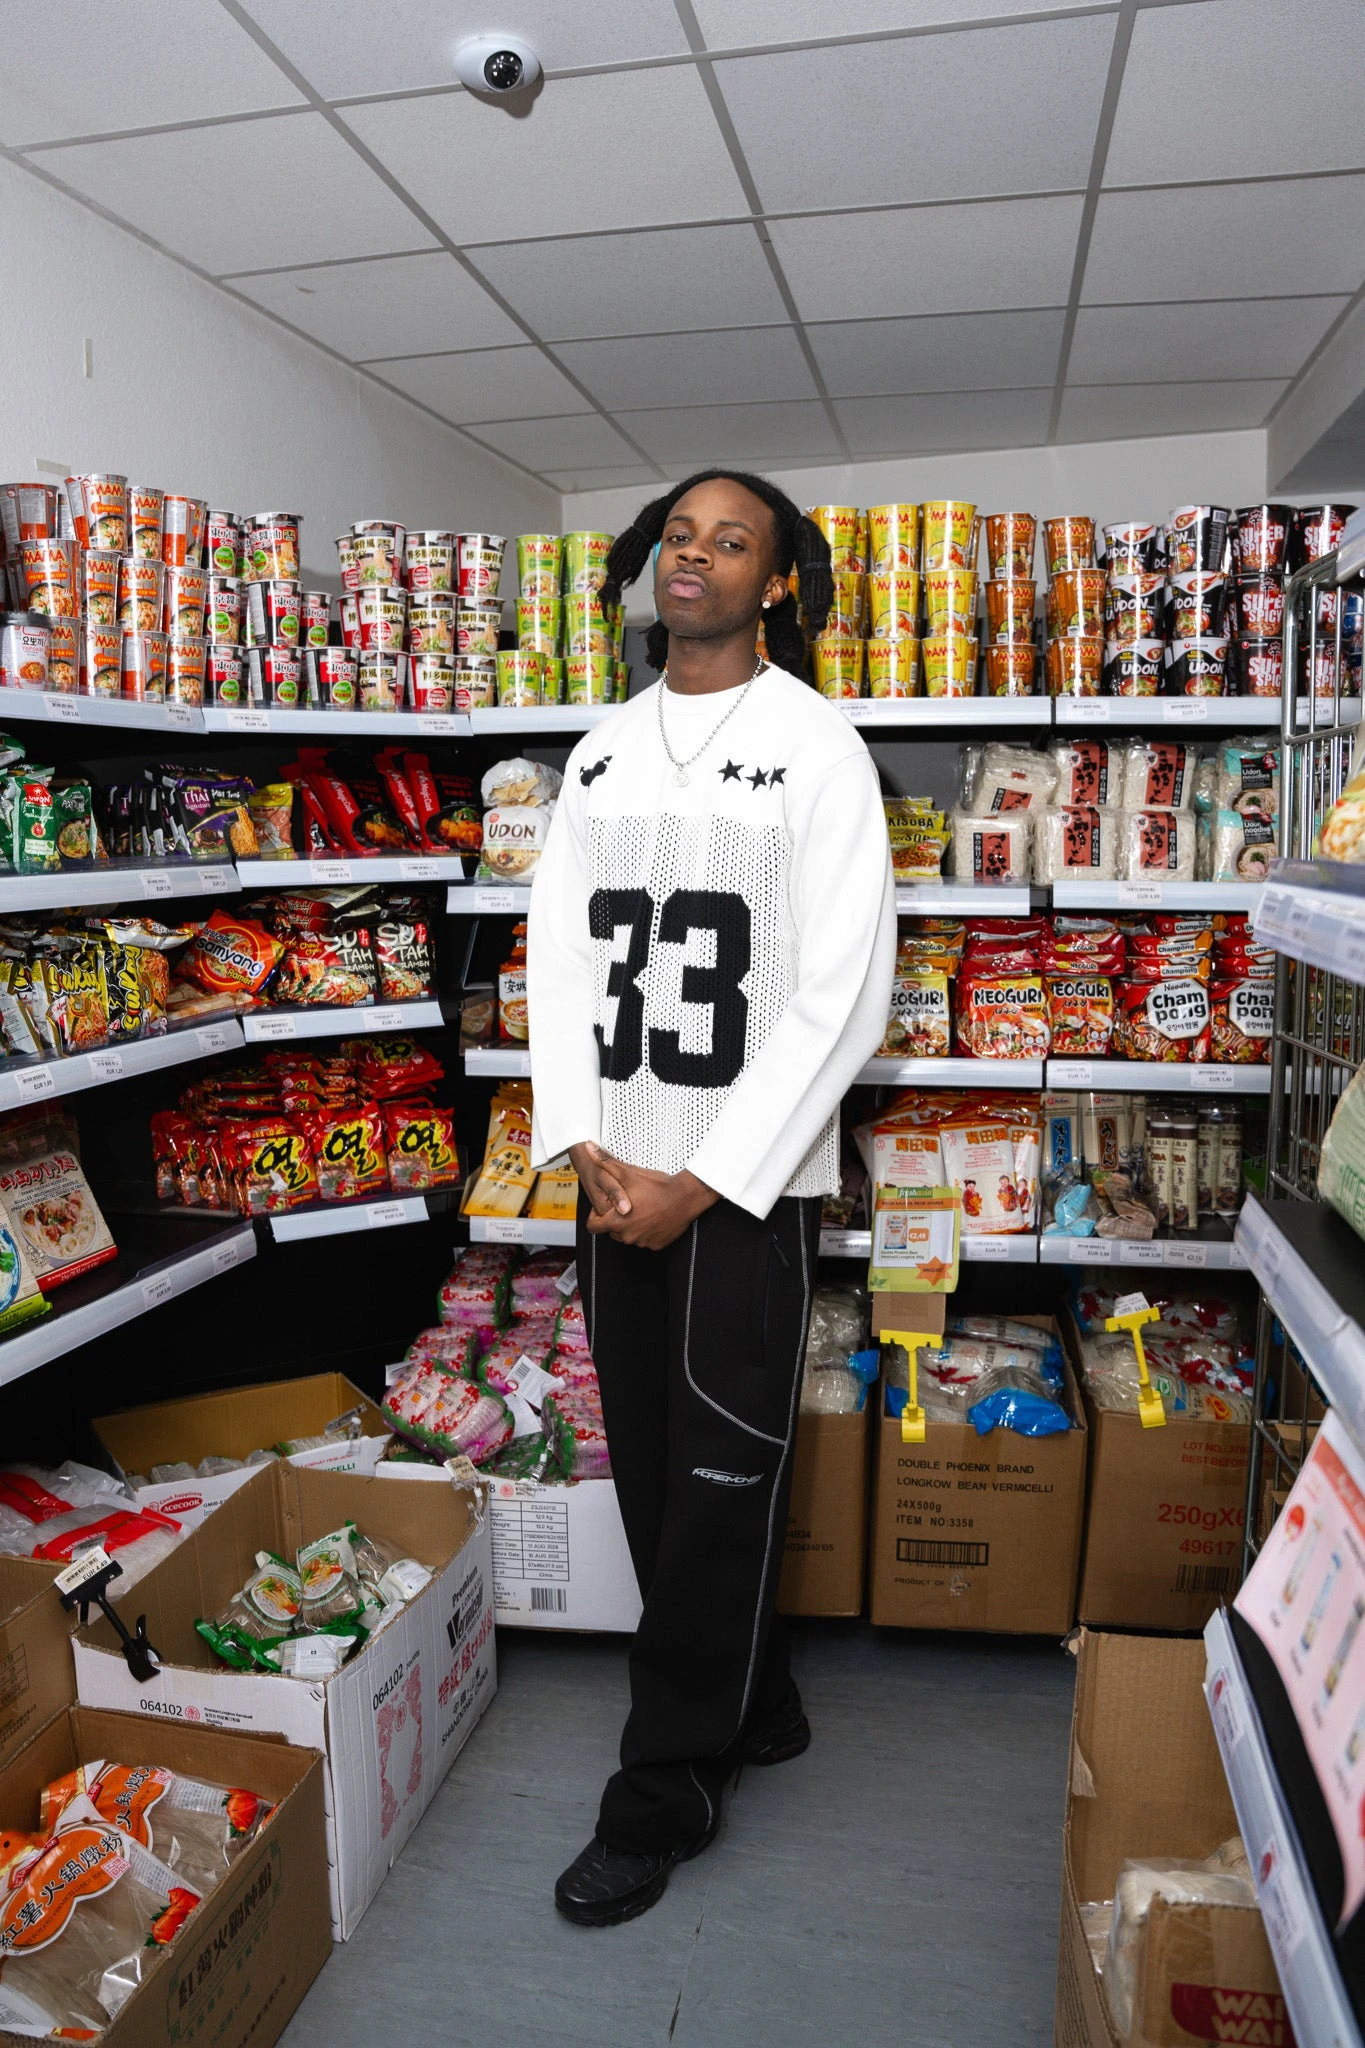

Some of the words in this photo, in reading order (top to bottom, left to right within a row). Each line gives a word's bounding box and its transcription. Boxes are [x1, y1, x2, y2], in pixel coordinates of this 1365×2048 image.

[1239, 525, 1284, 545] SUPER
[1242, 541, 1276, 557] SPICY
[1113, 597, 1148, 613] UDON
[823, 648, 857, 659] MAMA
[1121, 663, 1158, 675] UDON
[1188, 660, 1224, 674] UDON
[182, 789, 210, 803] Thai
[488, 824, 537, 839] UDON
[1175, 922, 1212, 931] Champong
[196, 935, 262, 978] samyang
[336, 948, 374, 965] TAH
[396, 944, 429, 961] TAH
[1158, 944, 1195, 953] Champong
[345, 963, 375, 972] RAMEN
[401, 960, 431, 969] RAMEN
[1161, 966, 1198, 975] Champong
[226, 968, 256, 987] Ramen
[588, 887, 751, 1089] 33
[1164, 982, 1191, 992] Noodle
[890, 990, 944, 1006] EOGURI
[973, 987, 1043, 1007] NEOGURI
[1152, 992, 1204, 1009] Cham
[1236, 992, 1274, 1008] Cha
[1236, 1006, 1274, 1020] pon
[34, 1082, 44, 1090] EUR
[324, 1126, 378, 1178] 열
[400, 1122, 451, 1169] 열
[1101, 1121, 1115, 1167] うどん
[253, 1136, 310, 1192] 열
[897, 1458, 940, 1470] DOUBLE
[946, 1462, 990, 1473] PHOENIX
[997, 1463, 1035, 1474] BRAND
[1182, 1454, 1208, 1464] BEST
[896, 1477, 951, 1489] LONGKOW
[957, 1481, 987, 1491] BEAN
[992, 1483, 1054, 1493] VERMICELLI
[896, 1498, 942, 1513] 24X500g
[896, 1514, 922, 1526] ITEM
[1179, 1538, 1237, 1556] 49617
[83, 1569, 96, 1580] EUR
[894, 1577, 930, 1586] PRODUCT
[451, 1565, 478, 1608] Premium
[372, 1663, 404, 1711] 064102
[140, 1699, 183, 1717] 064102
[1212, 1990, 1284, 2020] WAI
[1210, 2014, 1284, 2047] WAI
